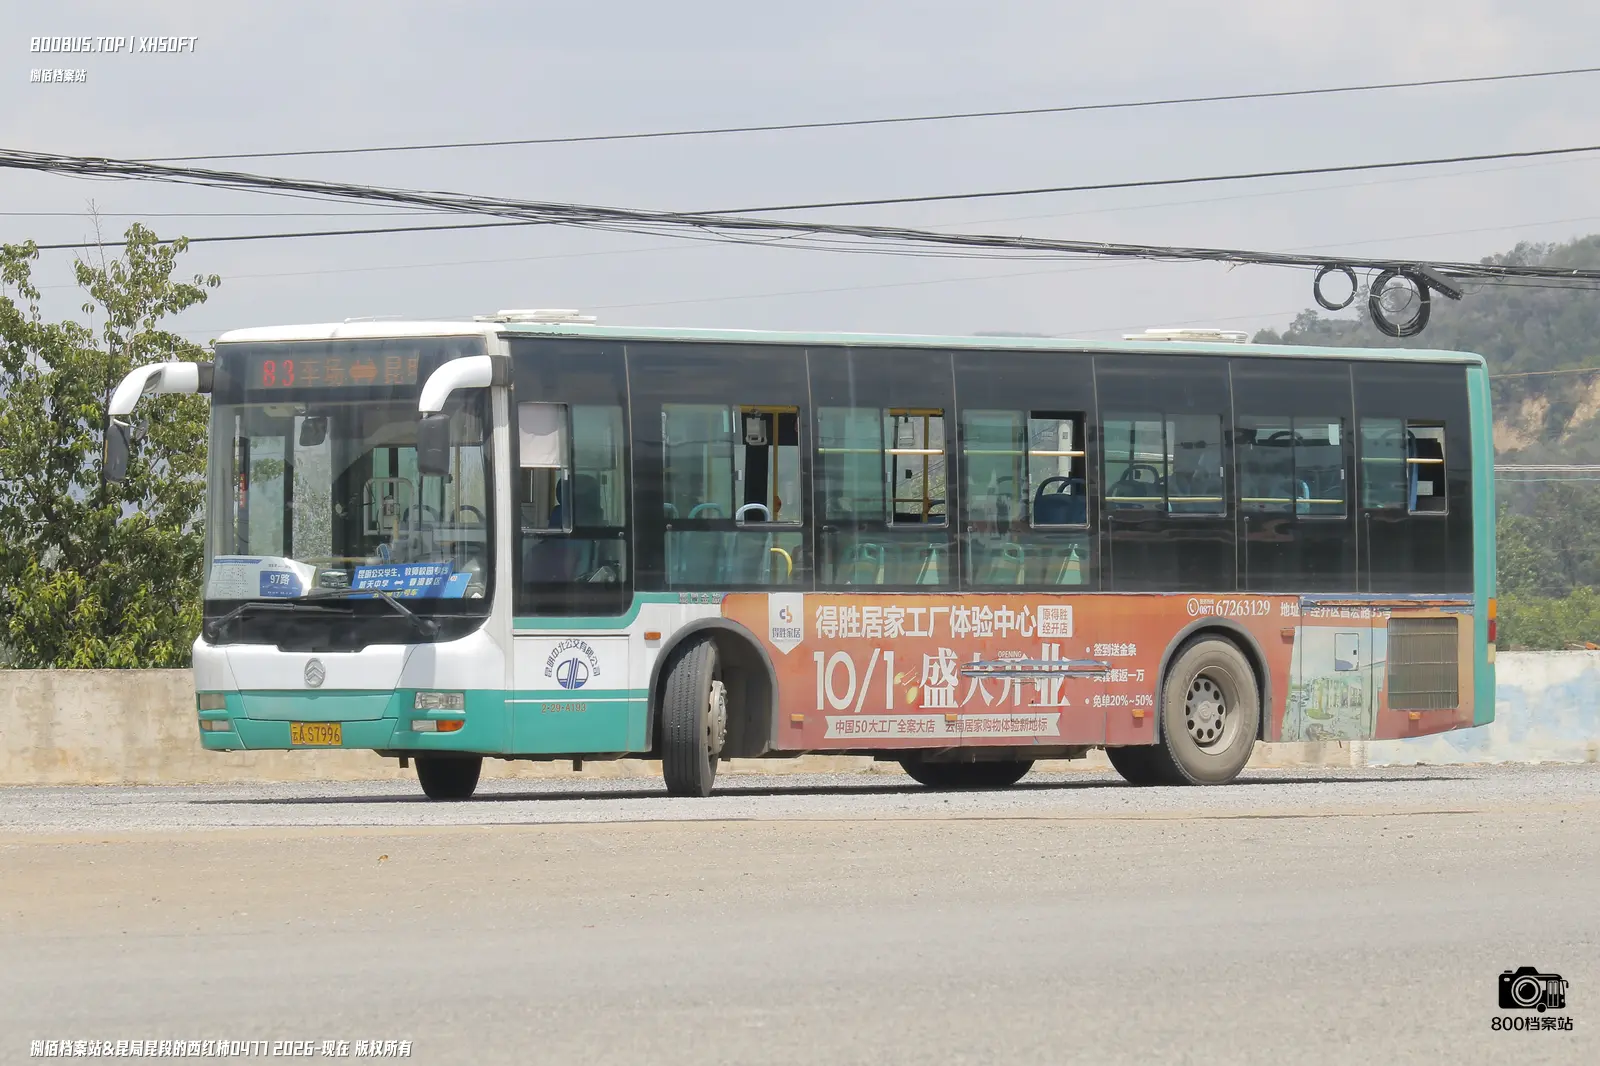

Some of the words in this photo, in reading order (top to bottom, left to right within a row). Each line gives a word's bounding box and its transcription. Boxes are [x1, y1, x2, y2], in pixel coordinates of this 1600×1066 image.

[262, 359, 295, 387] 83
[270, 573, 290, 585] 97路
[1042, 608, 1068, 621] 原得胜
[1199, 605, 1214, 615] 0871
[1216, 600, 1271, 616] 67263129
[816, 605, 1037, 639] 得胜居家工厂体验中心
[1042, 622, 1068, 635] 经开店
[544, 638, 601, 678] 昆明中北公交有限公司
[997, 650, 1022, 658] OPENING
[1093, 643, 1137, 657] 签到送金条
[813, 648, 895, 713] 10/1
[919, 642, 1071, 709] 盛大开业
[1093, 694, 1154, 708] 免单20%~50%
[835, 719, 935, 734] 中国50大工厂全案大店
[945, 717, 1048, 733] 云南居家购物体验新地标
